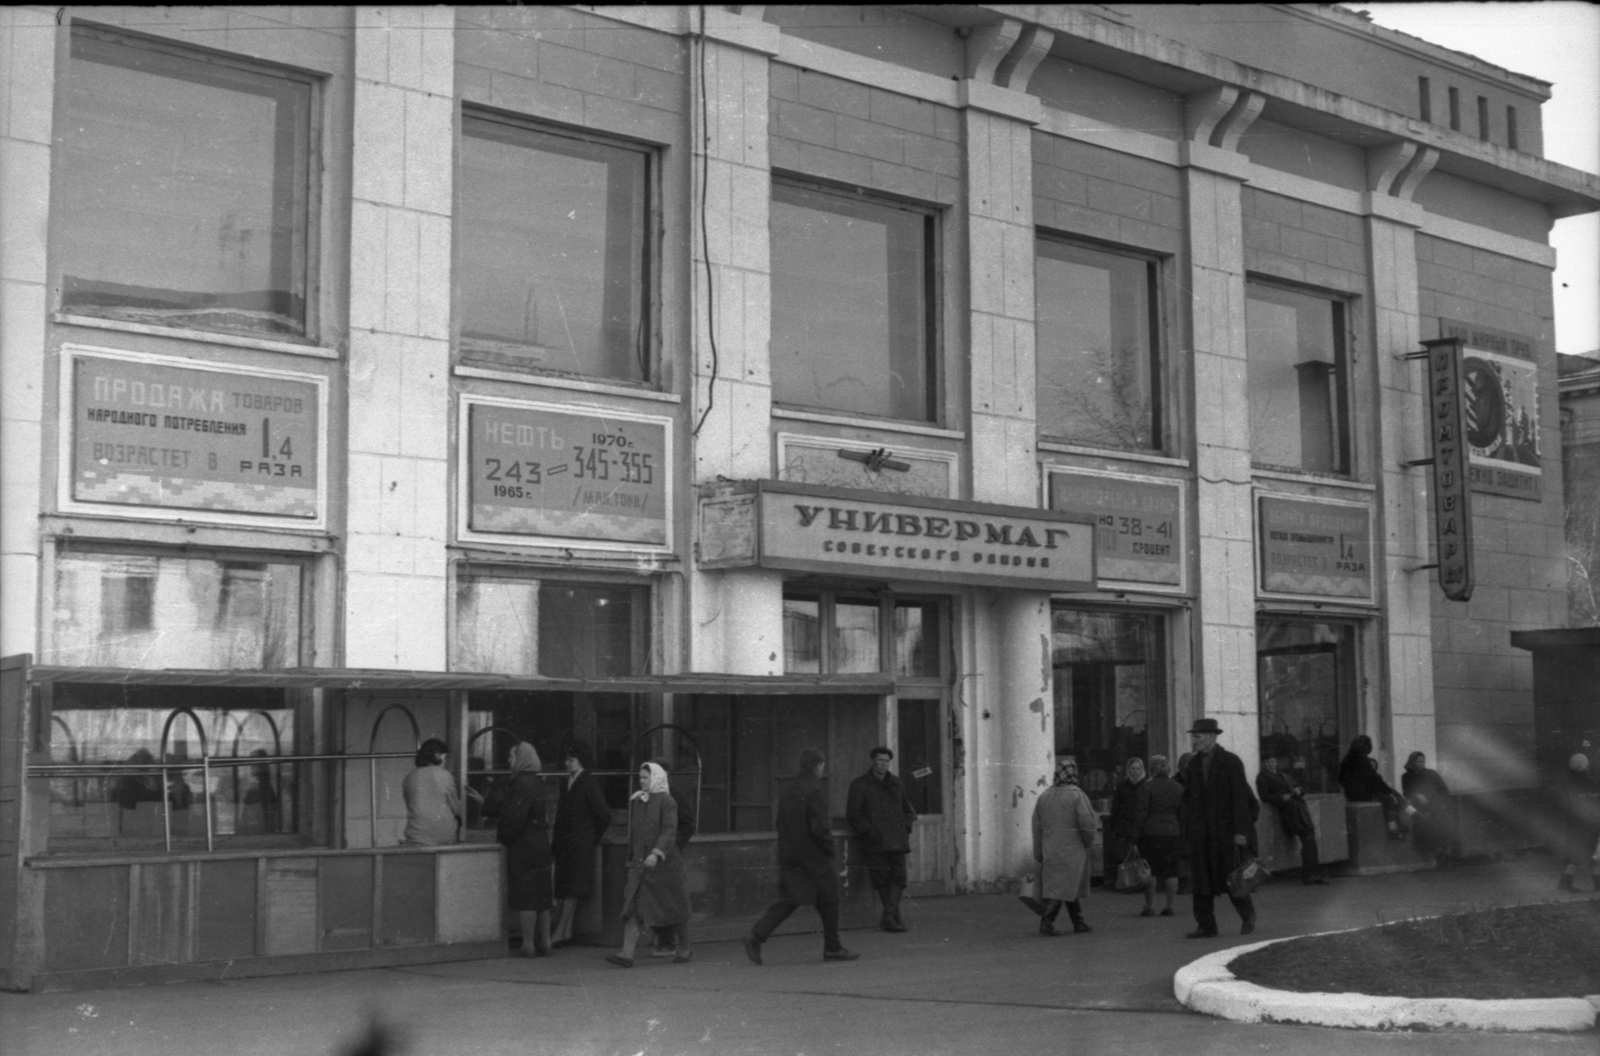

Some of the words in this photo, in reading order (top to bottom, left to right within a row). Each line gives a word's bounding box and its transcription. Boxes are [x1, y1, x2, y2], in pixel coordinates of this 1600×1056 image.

[95, 376, 224, 413] ПРОДАЖА
[231, 392, 302, 414] ТОВАРОВ
[88, 408, 157, 427] НАРОДНОГО
[164, 415, 246, 436] ПОТРЕБЛЕНИЯ
[485, 421, 564, 450] НЕФТЬ
[92, 442, 191, 468] ВОЗРАСТЕТ
[208, 452, 218, 471] В
[240, 460, 302, 478] РАЗА
[485, 457, 541, 484] 243
[1436, 354, 1464, 584] ПРОМТОВАРЫ
[794, 504, 1070, 549] УНИВЕРМАГ
[1133, 542, 1171, 556] ПРОЦЕНТ
[1336, 561, 1366, 572] РАЗА
